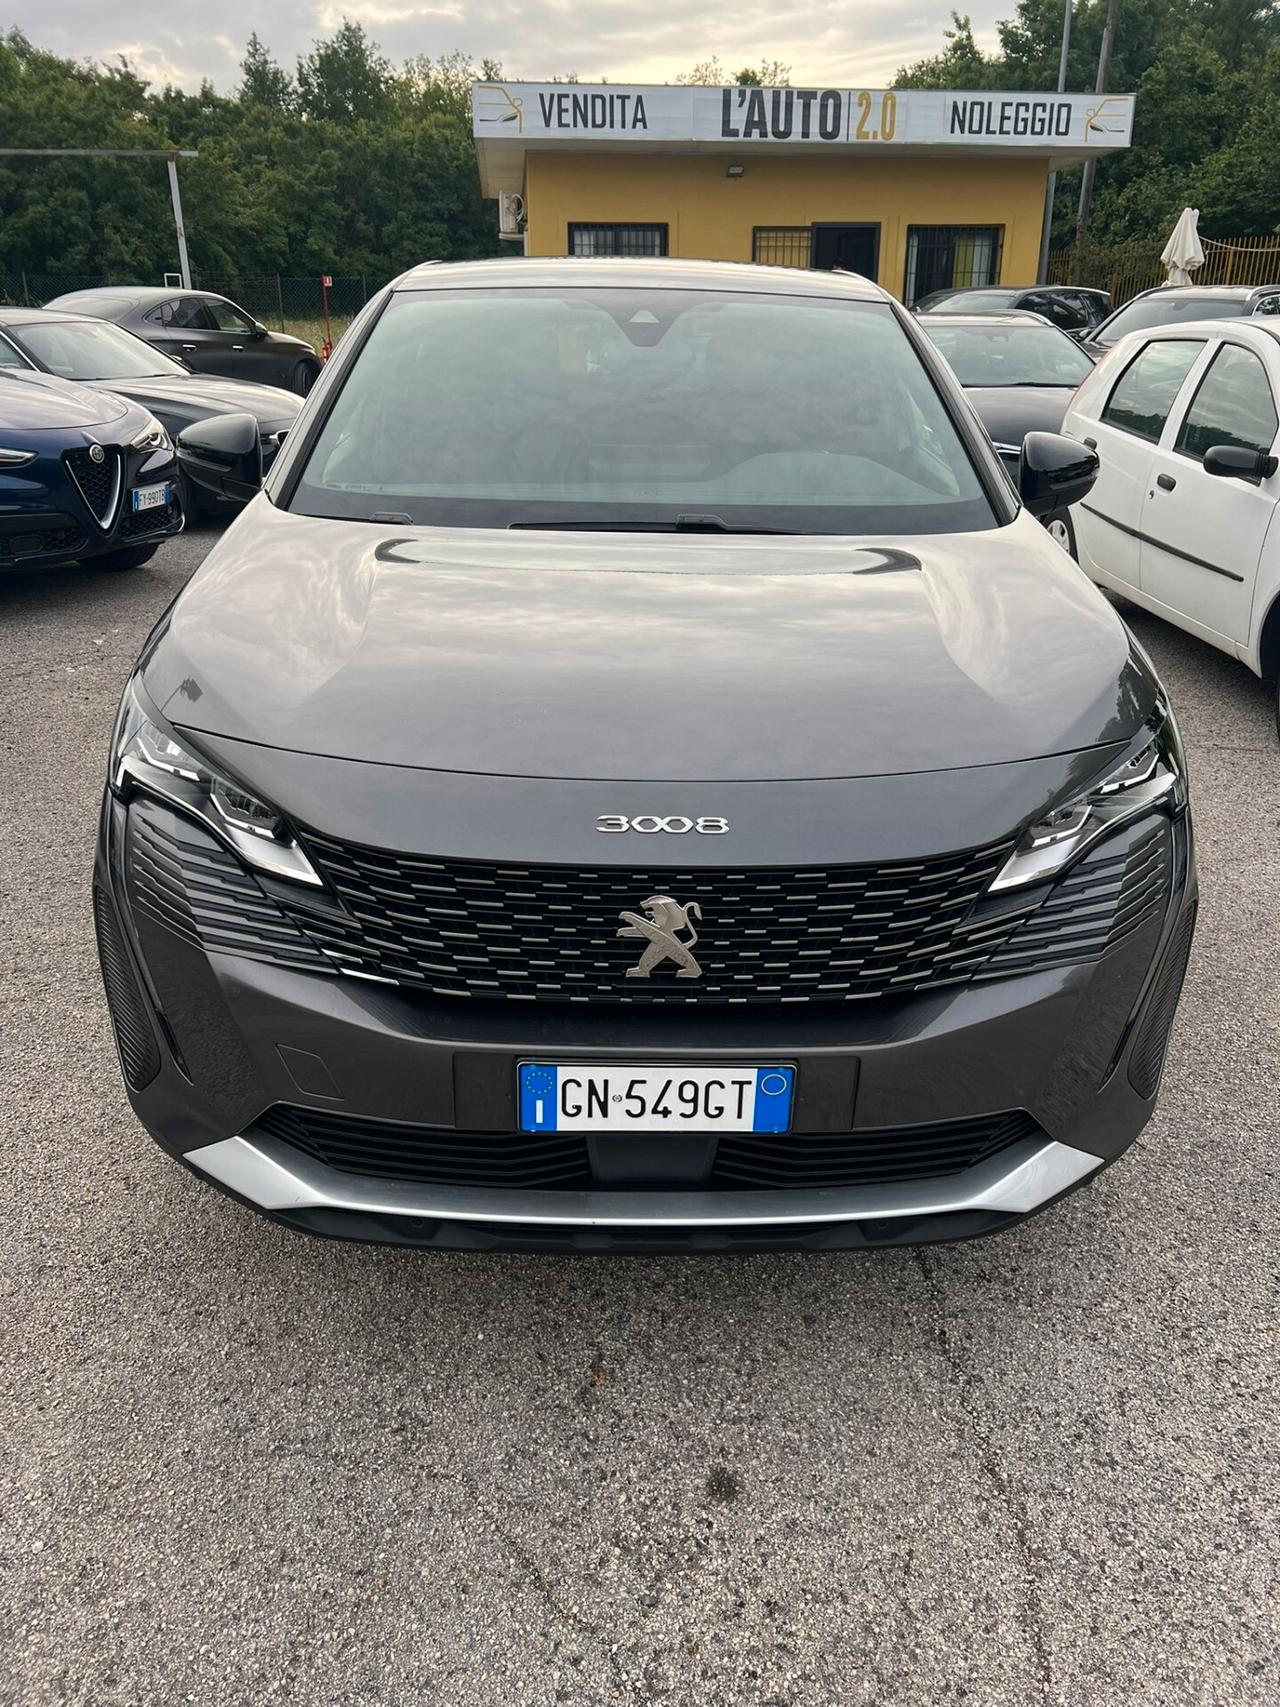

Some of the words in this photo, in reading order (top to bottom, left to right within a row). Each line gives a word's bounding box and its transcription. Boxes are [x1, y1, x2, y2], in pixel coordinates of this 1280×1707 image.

[539, 93, 648, 129] VENDITA
[721, 88, 842, 140] L'AUTO
[856, 91, 896, 141] 2.0
[950, 101, 1072, 136] NOLEGGIO
[596, 815, 730, 834] 3008
